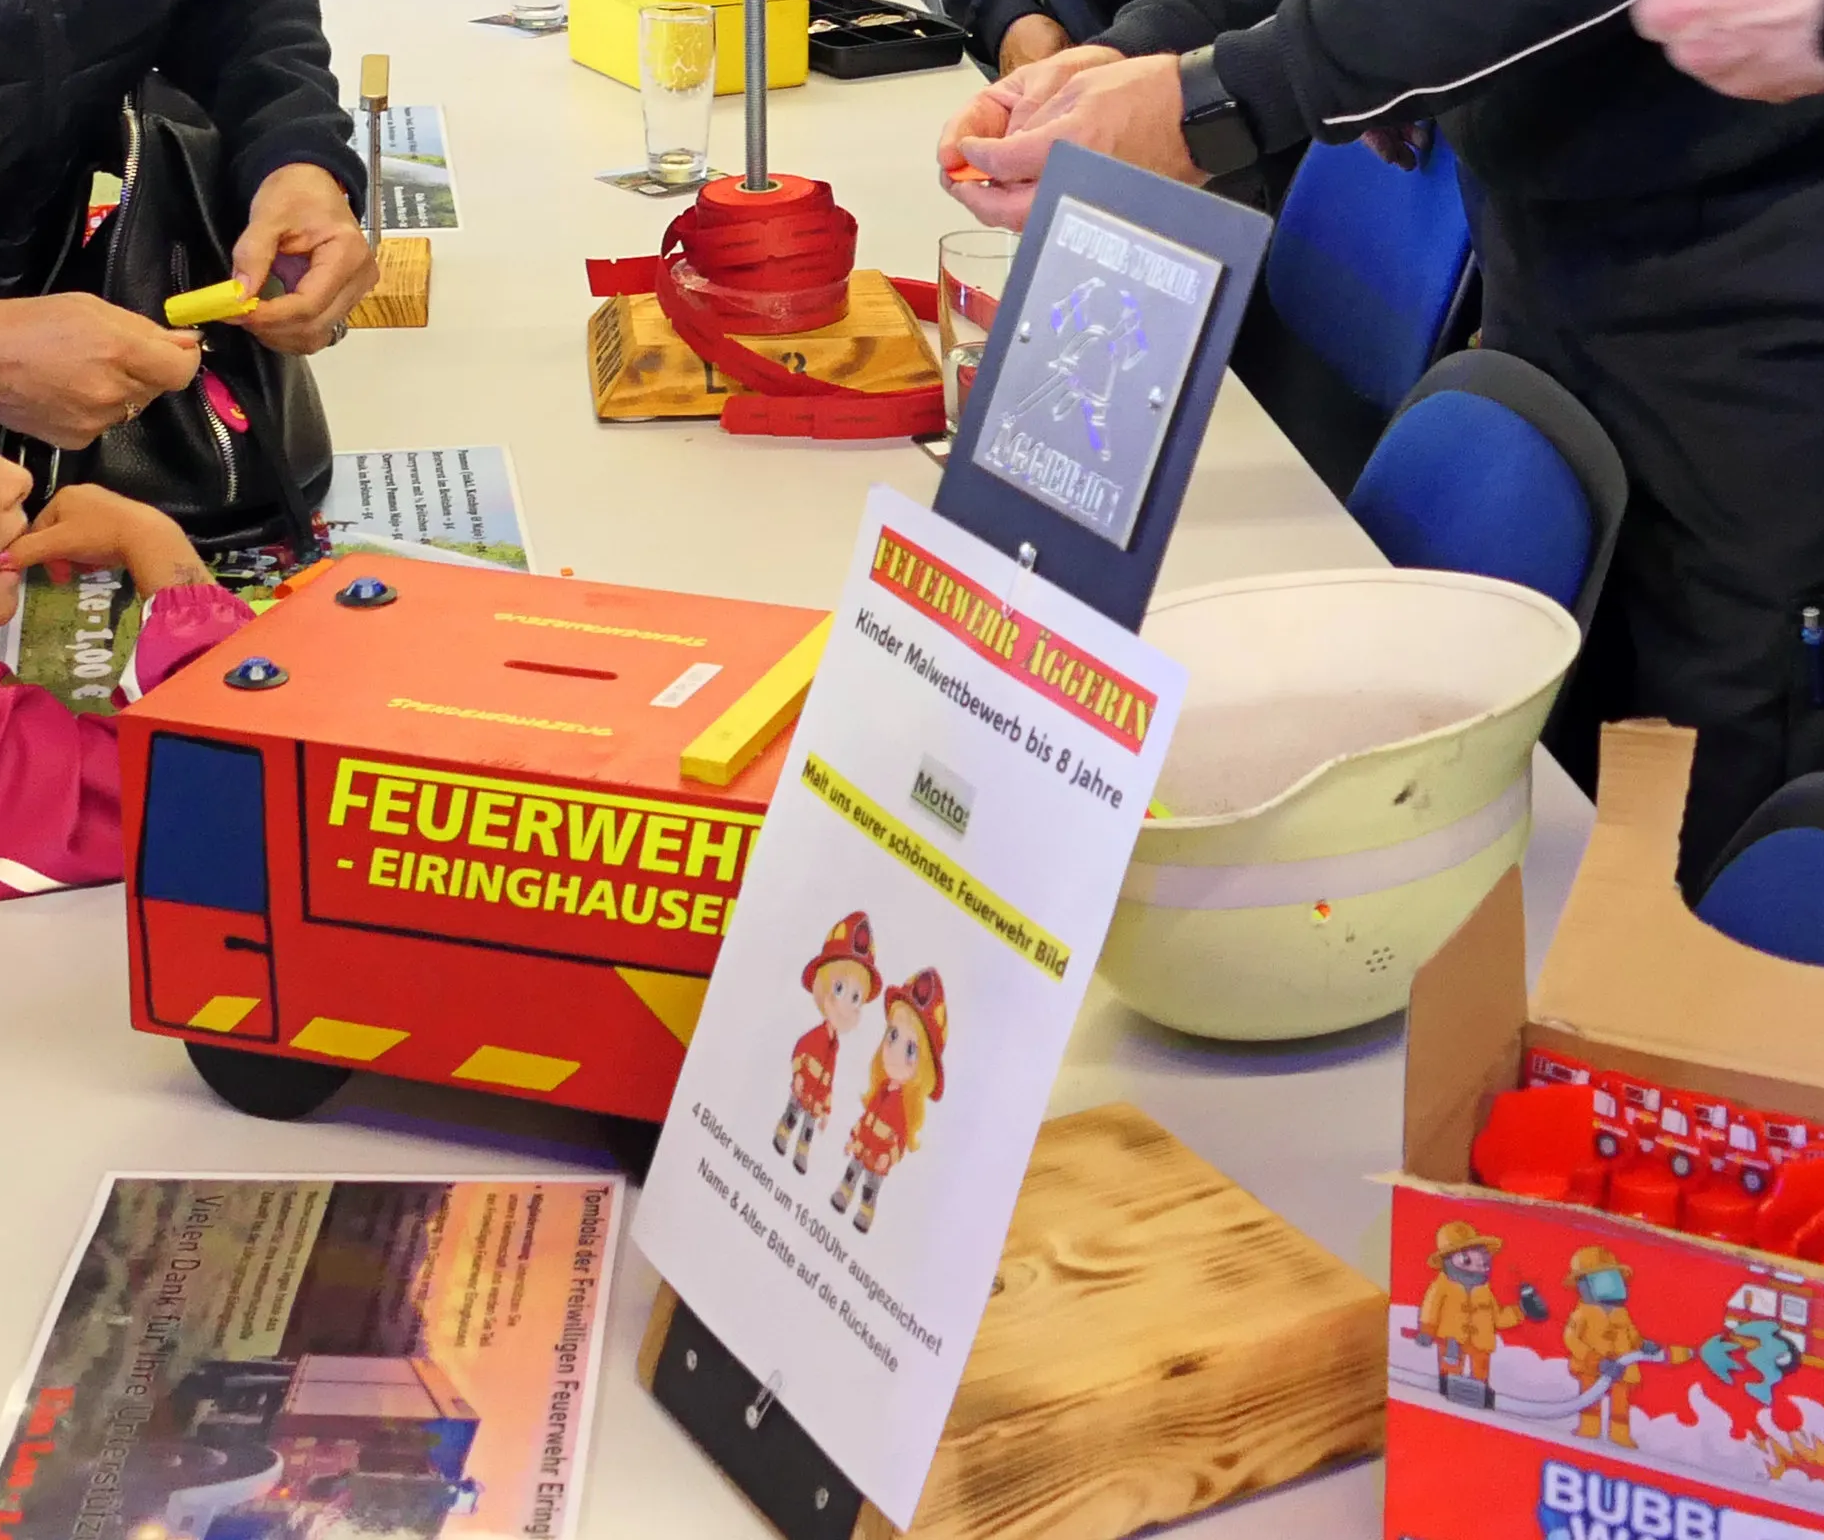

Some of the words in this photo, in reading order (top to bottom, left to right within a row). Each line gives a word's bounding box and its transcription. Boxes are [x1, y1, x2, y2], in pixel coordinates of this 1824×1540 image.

[65, 628, 113, 678] 1,00
[872, 534, 1021, 662] FEUERWEHR
[1022, 625, 1155, 743] ÄGGERIN
[72, 684, 111, 701] €
[855, 607, 904, 657] Kinder
[905, 643, 1022, 743] Malwettbewerb
[1025, 721, 1052, 764] bis
[1055, 748, 1071, 774] 8
[1071, 759, 1124, 810] Jahre
[912, 770, 971, 827] Motto:
[801, 760, 829, 794] Malt
[829, 783, 851, 815] uns
[852, 803, 888, 841] eurer
[887, 828, 955, 894] schönstes
[955, 883, 1035, 954] Feuerwehr
[1034, 940, 1069, 980] Bild
[178, 1195, 225, 1251] Vielen
[578, 1186, 610, 1246] Tombola
[691, 1101, 701, 1120] 4
[699, 1108, 733, 1152] Bilder
[731, 1143, 774, 1193] werden
[773, 1186, 793, 1212] um
[794, 1202, 849, 1265] 16:00Uhr
[848, 1260, 943, 1357] ausgezeichnet
[157, 1258, 200, 1306] Dank
[573, 1250, 597, 1273] der
[697, 1156, 731, 1201] Name
[729, 1190, 740, 1211] &
[739, 1201, 768, 1239] Alter
[767, 1229, 796, 1270] Bitte
[796, 1262, 819, 1291] auf
[817, 1278, 839, 1310] die
[838, 1298, 899, 1374] Rückseite
[143, 1315, 182, 1342] für
[554, 1278, 594, 1374] Freiwilligen
[125, 1352, 169, 1396] Ihre
[540, 1381, 579, 1476] Feuerwehr
[1542, 1460, 1717, 1540] BUBB
